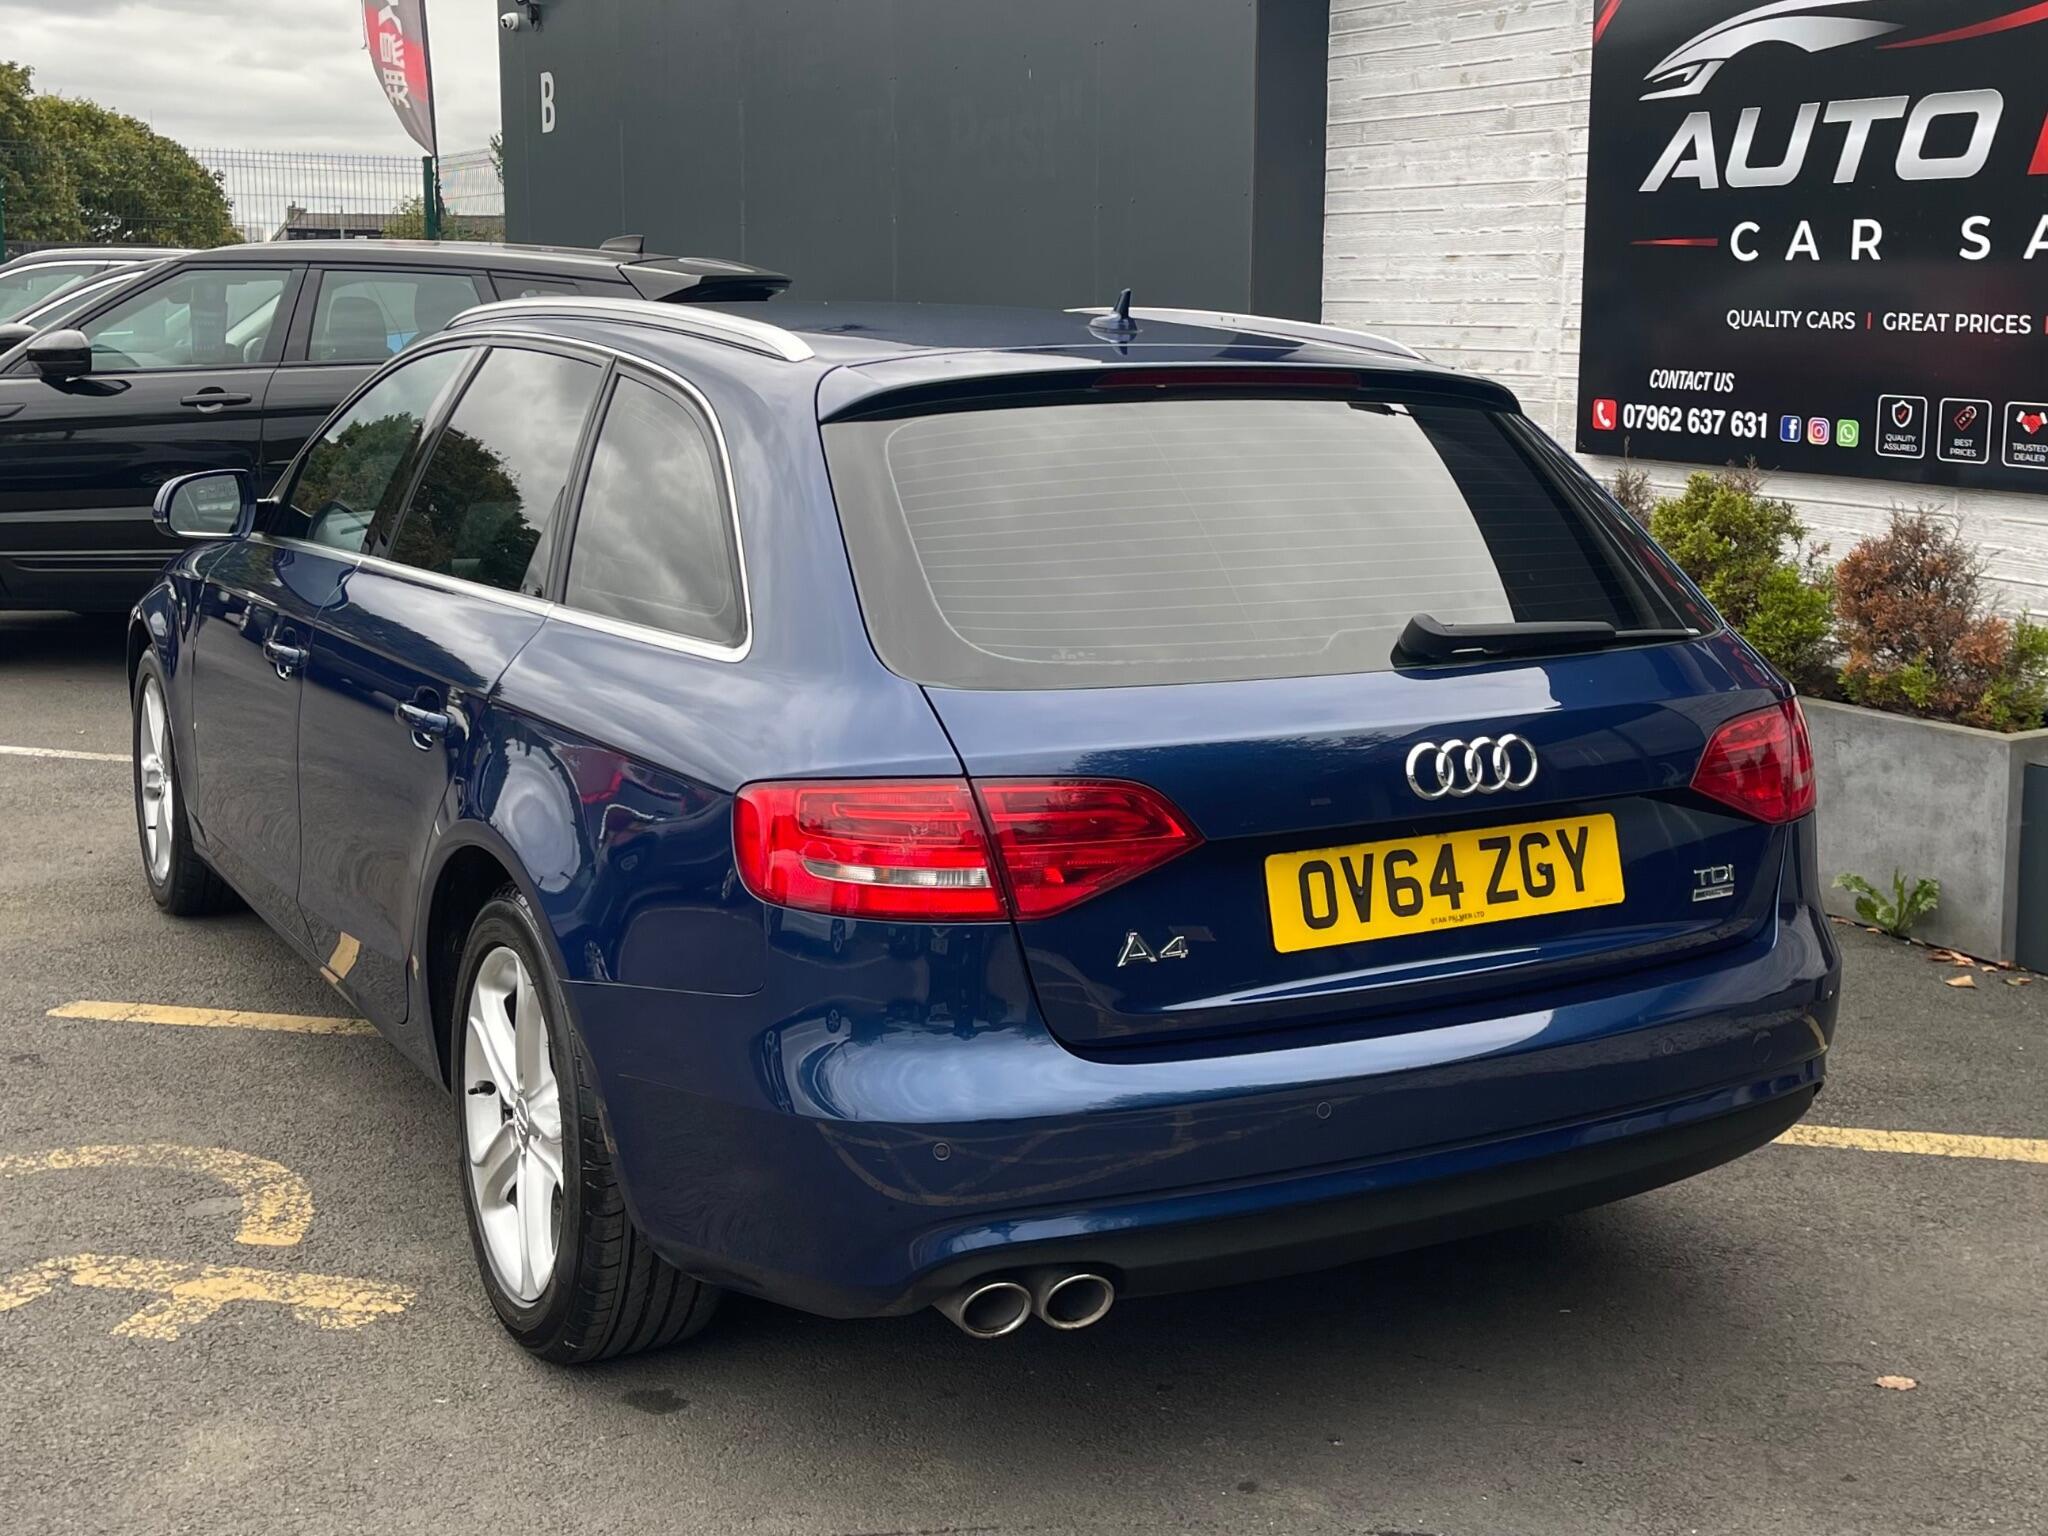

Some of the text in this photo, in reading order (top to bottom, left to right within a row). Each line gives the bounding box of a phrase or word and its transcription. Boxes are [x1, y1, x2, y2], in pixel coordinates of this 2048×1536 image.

[540, 71, 556, 134] B
[1639, 89, 2004, 192] AUTO
[1729, 218, 1883, 262] CAR
[1726, 309, 2032, 335] QUALITY CARS GREAT PRICES
[1649, 368, 1735, 393] CONTACT US
[1622, 404, 1683, 433] 07962
[1687, 407, 1726, 436] 637
[1730, 410, 1768, 439] 631
[1883, 442, 1918, 453] ASSURED
[1885, 433, 1917, 443] QUALITY
[1954, 438, 1974, 448] BEST
[2012, 442, 2048, 454] TRUSTED
[1949, 447, 1977, 458] PRICES
[2013, 452, 2046, 463] DEALER
[1298, 826, 1590, 931] OV64 ZGY
[1693, 864, 1735, 886] TDI
[1117, 931, 1188, 967] A4
